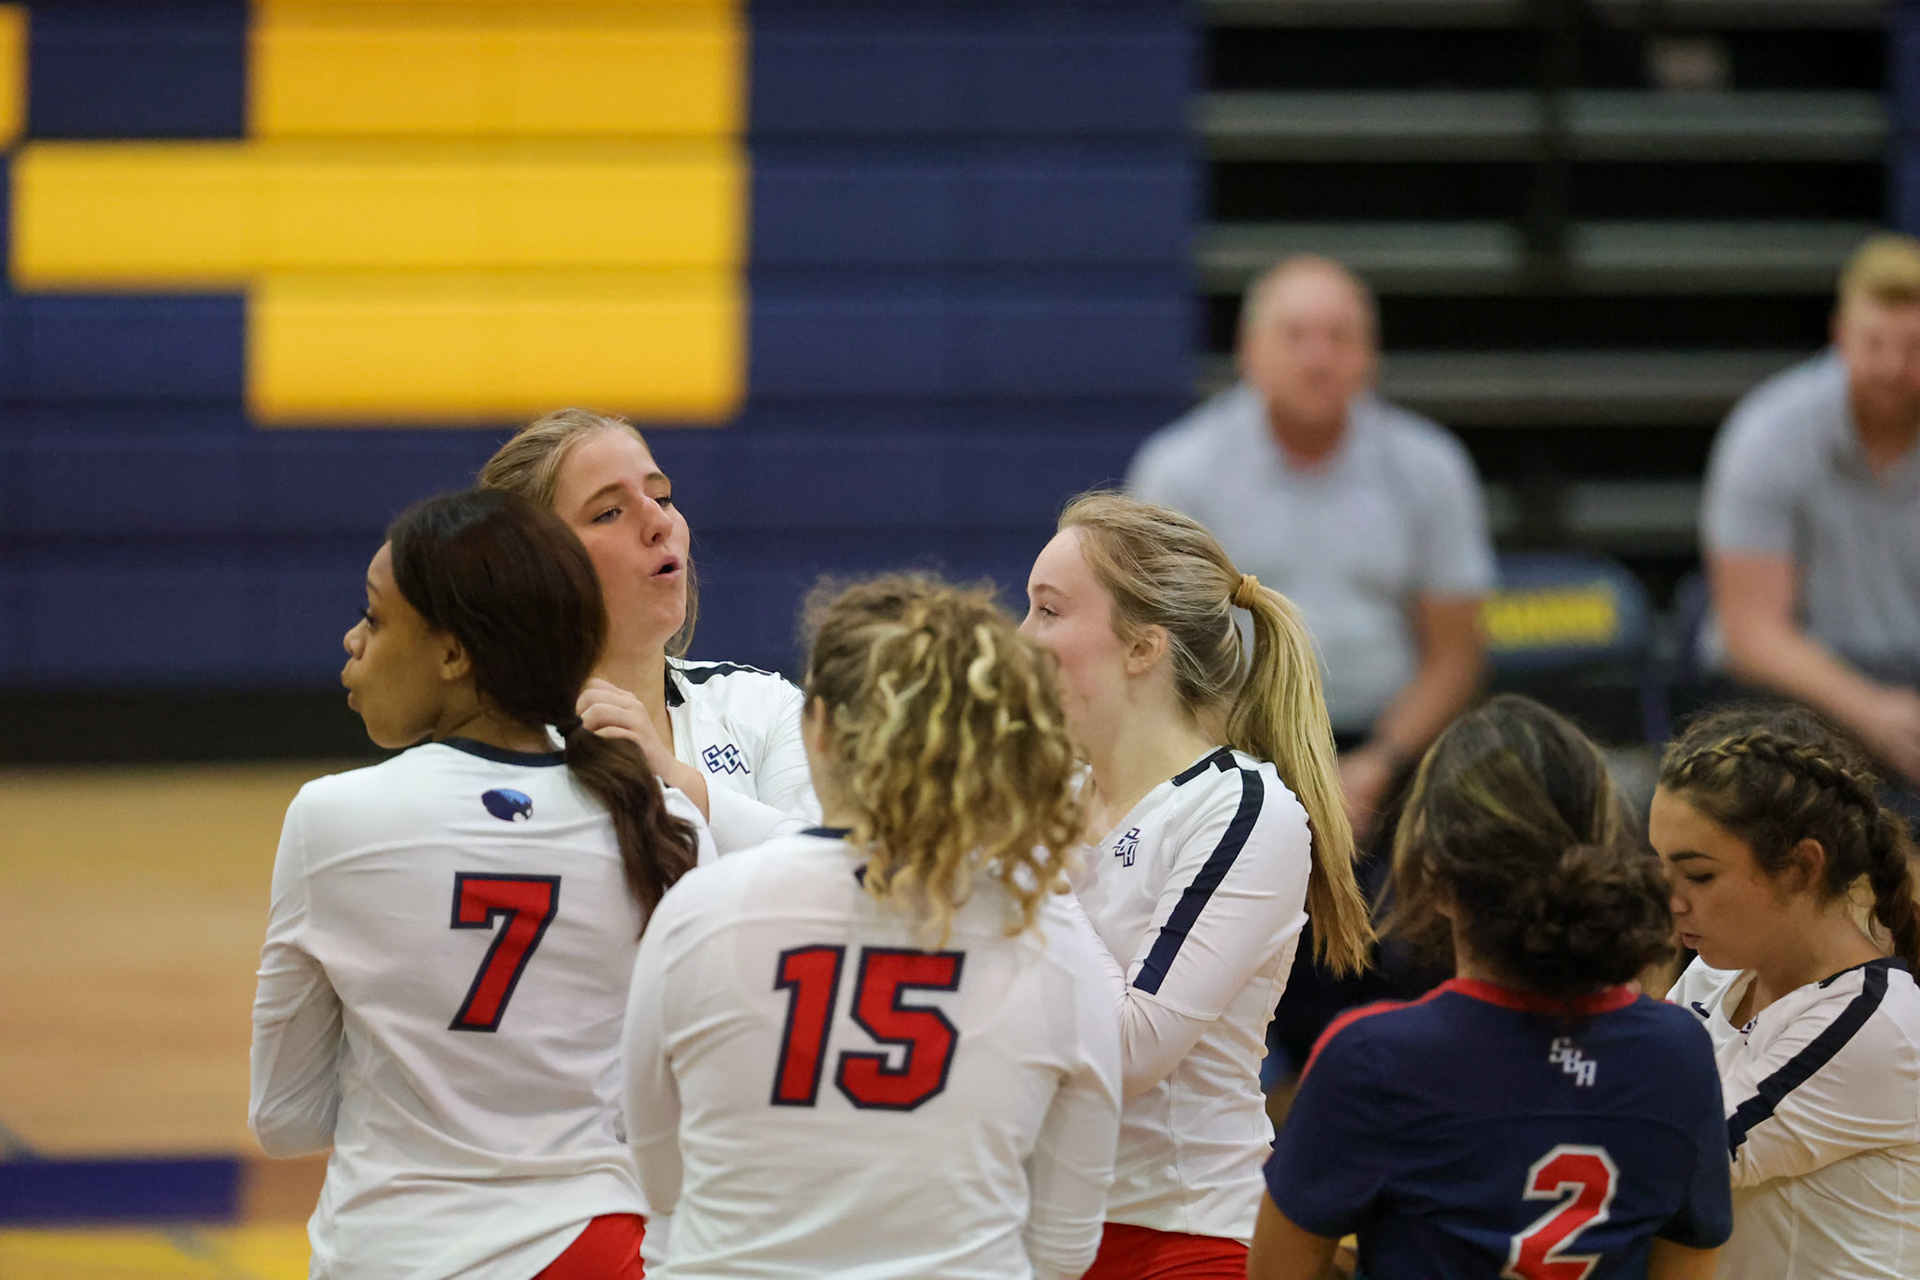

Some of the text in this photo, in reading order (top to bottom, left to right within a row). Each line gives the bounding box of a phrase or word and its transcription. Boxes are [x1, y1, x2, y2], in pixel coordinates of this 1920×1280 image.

[702, 743, 751, 775] SB
[448, 871, 561, 1032] 7
[770, 944, 966, 1112] 15
[1499, 1143, 1620, 1280] 2
